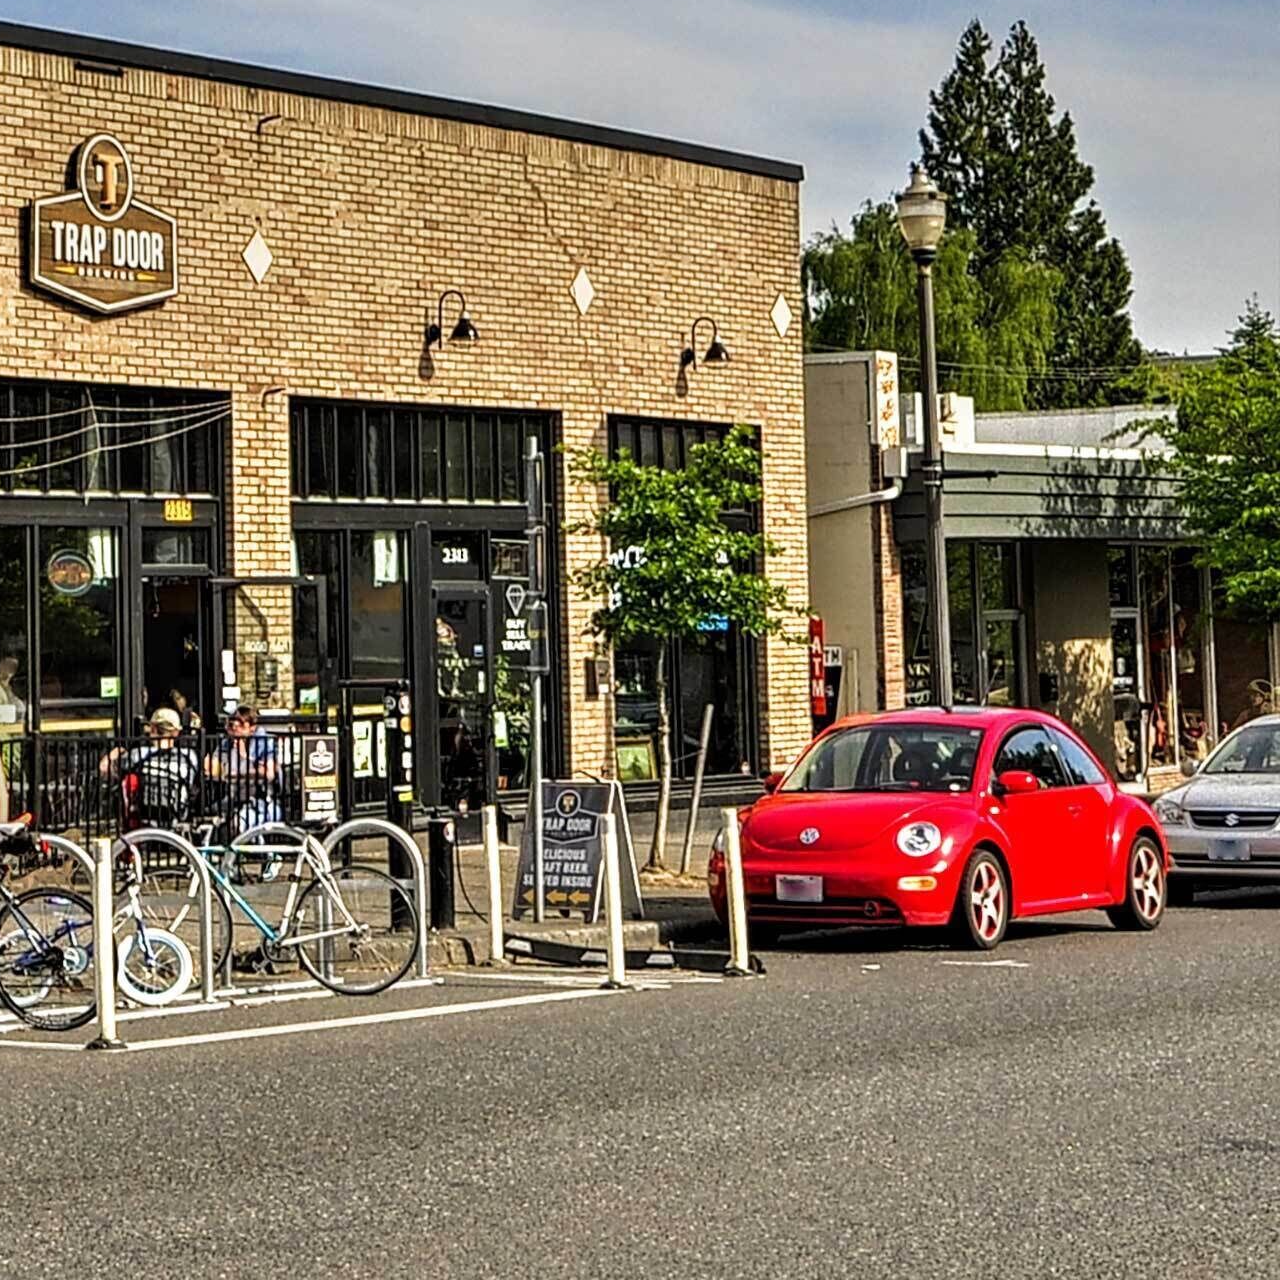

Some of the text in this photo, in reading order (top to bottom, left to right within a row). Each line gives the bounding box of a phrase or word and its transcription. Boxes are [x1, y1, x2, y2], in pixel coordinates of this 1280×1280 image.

[51, 220, 165, 271] TRAP DOOR
[505, 618, 527, 629] BUY
[505, 630, 527, 640] SELL
[812, 635, 824, 697] ATM
[566, 818, 592, 832] DOOR
[543, 848, 587, 860] ELICIOUS
[562, 862, 589, 874] BEER
[522, 874, 593, 887] SEED INSIDE
